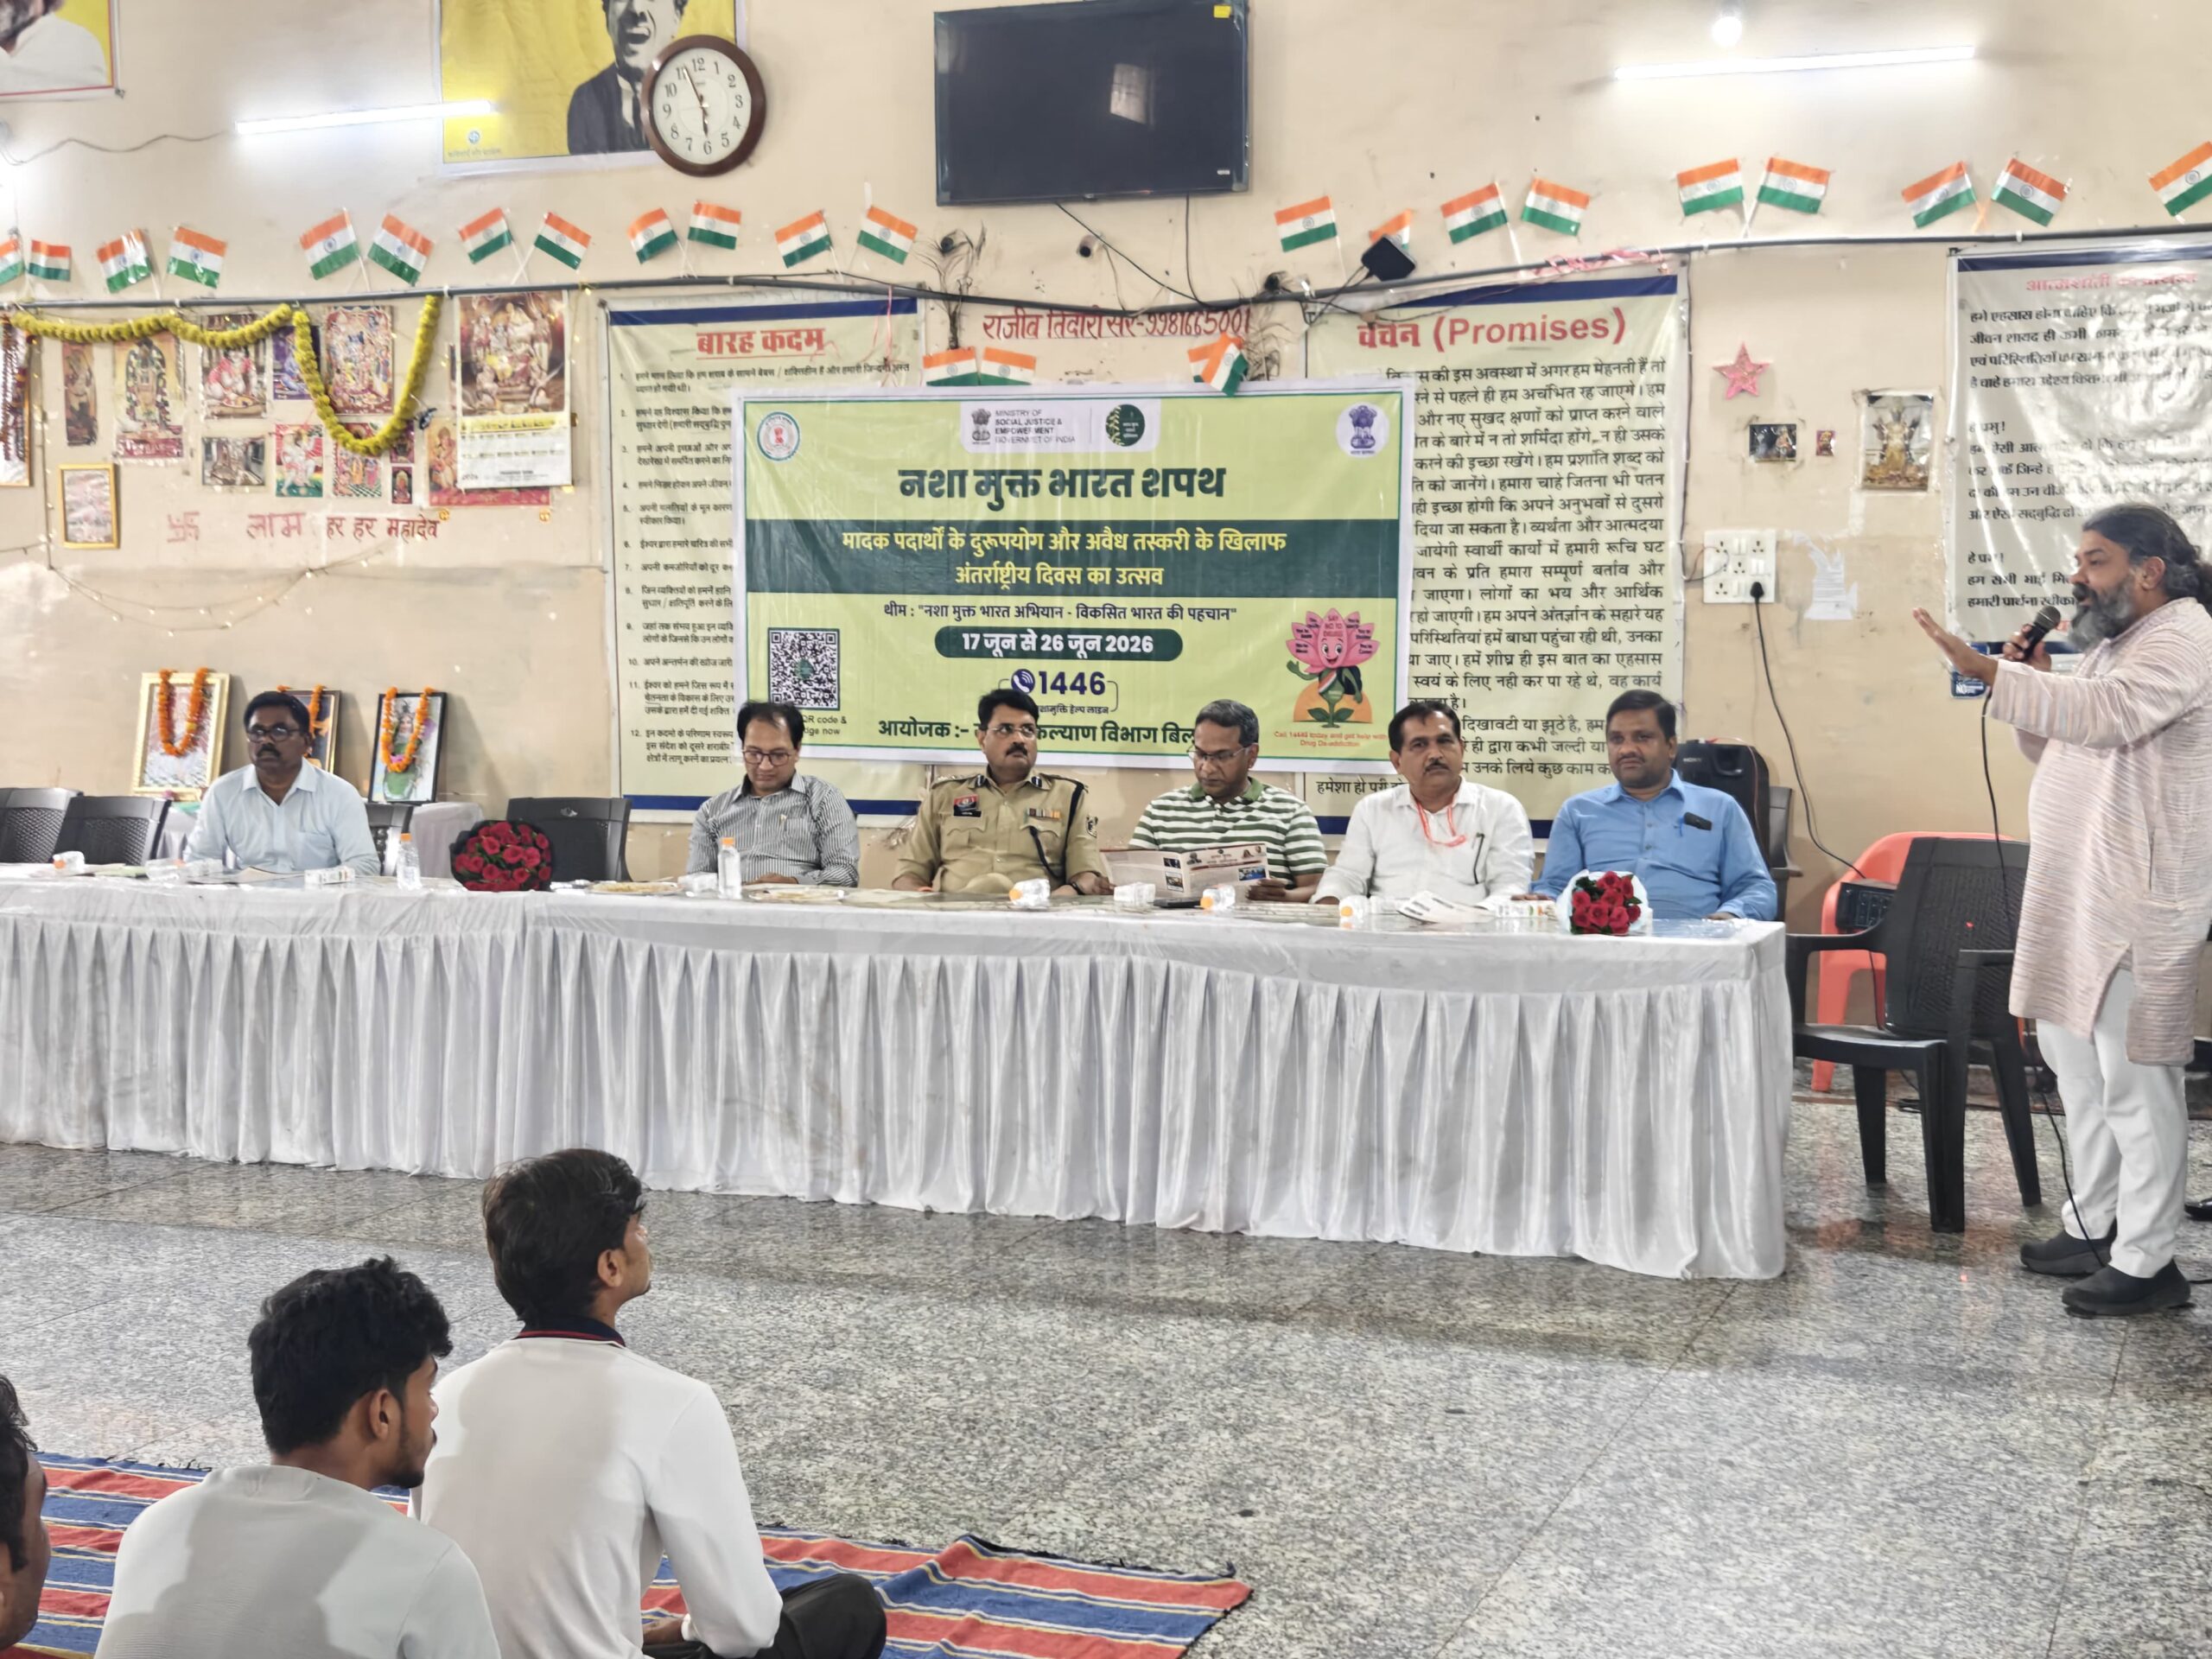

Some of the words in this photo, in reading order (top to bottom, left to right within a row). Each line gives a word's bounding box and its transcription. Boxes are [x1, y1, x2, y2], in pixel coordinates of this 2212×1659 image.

[692, 58, 705, 72] 12
[714, 61, 720, 75] 1
[728, 74, 736, 87] 2
[664, 83, 677, 98] 10
[735, 94, 743, 108] 3
[663, 104, 671, 118] 9
[671, 124, 679, 139] 8
[733, 116, 741, 130] 4
[685, 137, 693, 151] 7
[703, 141, 712, 155] 6
[721, 132, 729, 148] 5
[1357, 321, 1421, 349] वचन
[1433, 307, 1626, 353] (Promises)
[696, 330, 755, 355] बारह
[761, 327, 826, 354] कदम
[1418, 410, 1441, 426] और
[1446, 414, 1465, 429] नए
[1469, 413, 1505, 429] सुखद
[1545, 406, 1564, 422] को
[1569, 408, 1598, 421] प्राप्त
[1603, 403, 1630, 420] करने
[1636, 402, 1665, 418] वाले
[898, 469, 969, 499] नशा
[973, 469, 1042, 512] मुक्त
[1049, 468, 1135, 499] भारत
[1141, 467, 1227, 499] शपथ
[1432, 501, 1462, 516] इच्छा
[1466, 497, 1494, 514] होगी
[1499, 497, 1517, 512] कि
[1522, 495, 1554, 512] अपने
[1614, 493, 1627, 509] से
[327, 516, 346, 540] हर
[353, 518, 378, 543] हर
[386, 514, 441, 544] महादेव
[842, 532, 890, 550] मादक
[894, 526, 945, 552] पदार्थों
[948, 526, 967, 550] के
[969, 527, 1044, 558] दुरूपयोग
[1048, 525, 1080, 551] और
[1085, 525, 1128, 551] अवैध
[1132, 527, 1190, 551] तस्करी
[1194, 527, 1213, 551] के
[1218, 528, 1287, 551] खिलाफ
[1417, 541, 1458, 557] जायेगी
[1464, 540, 1503, 557] स्वार्थी
[1549, 539, 1560, 555] में
[1565, 538, 1599, 556] हमारी
[1606, 538, 1637, 554] रूचि
[1643, 542, 1664, 554] घट
[955, 560, 1032, 590] अंतर्राष्ट्रीय
[1035, 562, 1083, 586] दिवस
[1086, 568, 1111, 585] का
[1116, 567, 1165, 586] उत्सव
[1443, 563, 1458, 579] के
[1466, 563, 1491, 579] प्रति
[1500, 567, 1533, 580] हमारा
[1541, 561, 1583, 582] सम्पूर्ण
[1592, 560, 1630, 576] बर्ताव
[1638, 559, 1665, 575] और
[1520, 588, 1540, 600] का
[1548, 587, 1573, 599] भय
[1581, 582, 1607, 599] और
[1614, 582, 1663, 598] आर्थिक
[884, 601, 908, 617] थीम
[952, 606, 976, 622] मुक्त
[980, 606, 1010, 618] भारत
[1014, 602, 1064, 619] अभियान
[1076, 603, 1128, 620] विकसित
[1130, 607, 1162, 620] भारत
[1166, 603, 1184, 620] की
[962, 632, 980, 651] 17
[983, 633, 1017, 658] जून
[1020, 629, 1038, 652] से
[1040, 633, 1064, 652] 26
[1067, 634, 1103, 659] जून
[1105, 635, 1154, 653] 2026
[1484, 627, 1503, 646] हमें
[1580, 627, 1597, 645] रही
[1625, 631, 1663, 643] उनका
[1039, 671, 1106, 696] 1446
[878, 716, 951, 738] आयोजक
[1101, 721, 1159, 744] विभाग
